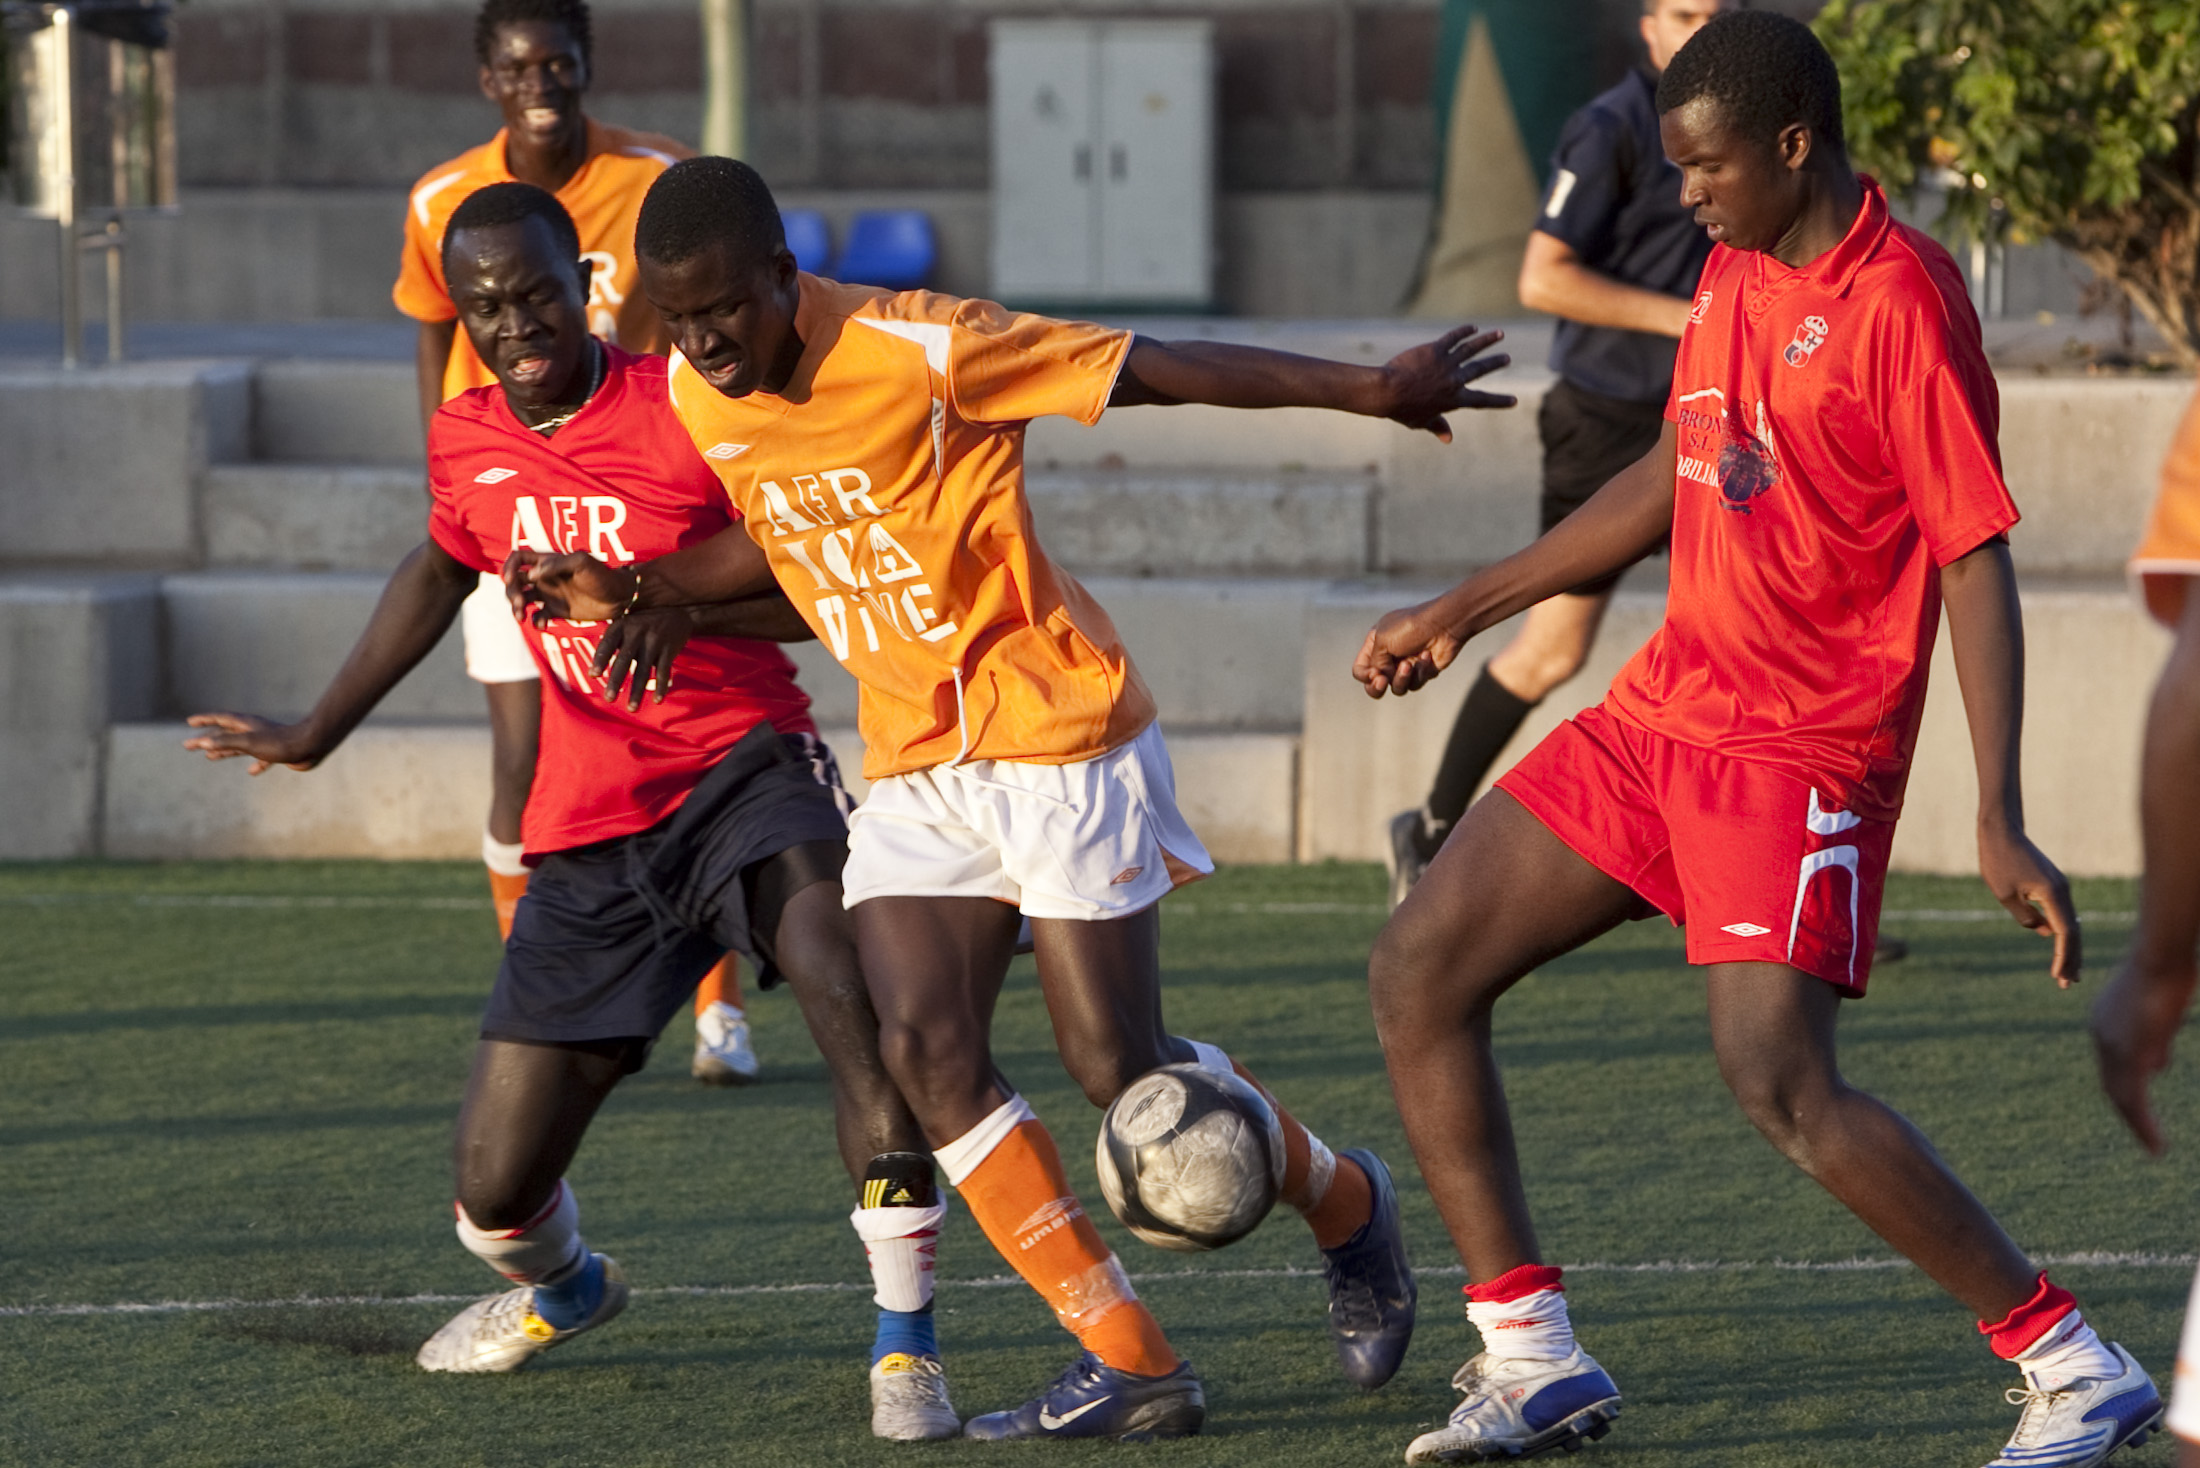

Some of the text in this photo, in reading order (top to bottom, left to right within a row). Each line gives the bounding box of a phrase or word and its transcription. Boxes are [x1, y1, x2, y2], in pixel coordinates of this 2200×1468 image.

[511, 496, 634, 562] AFR
[760, 467, 892, 537] AFR
[779, 523, 924, 591] ICA
